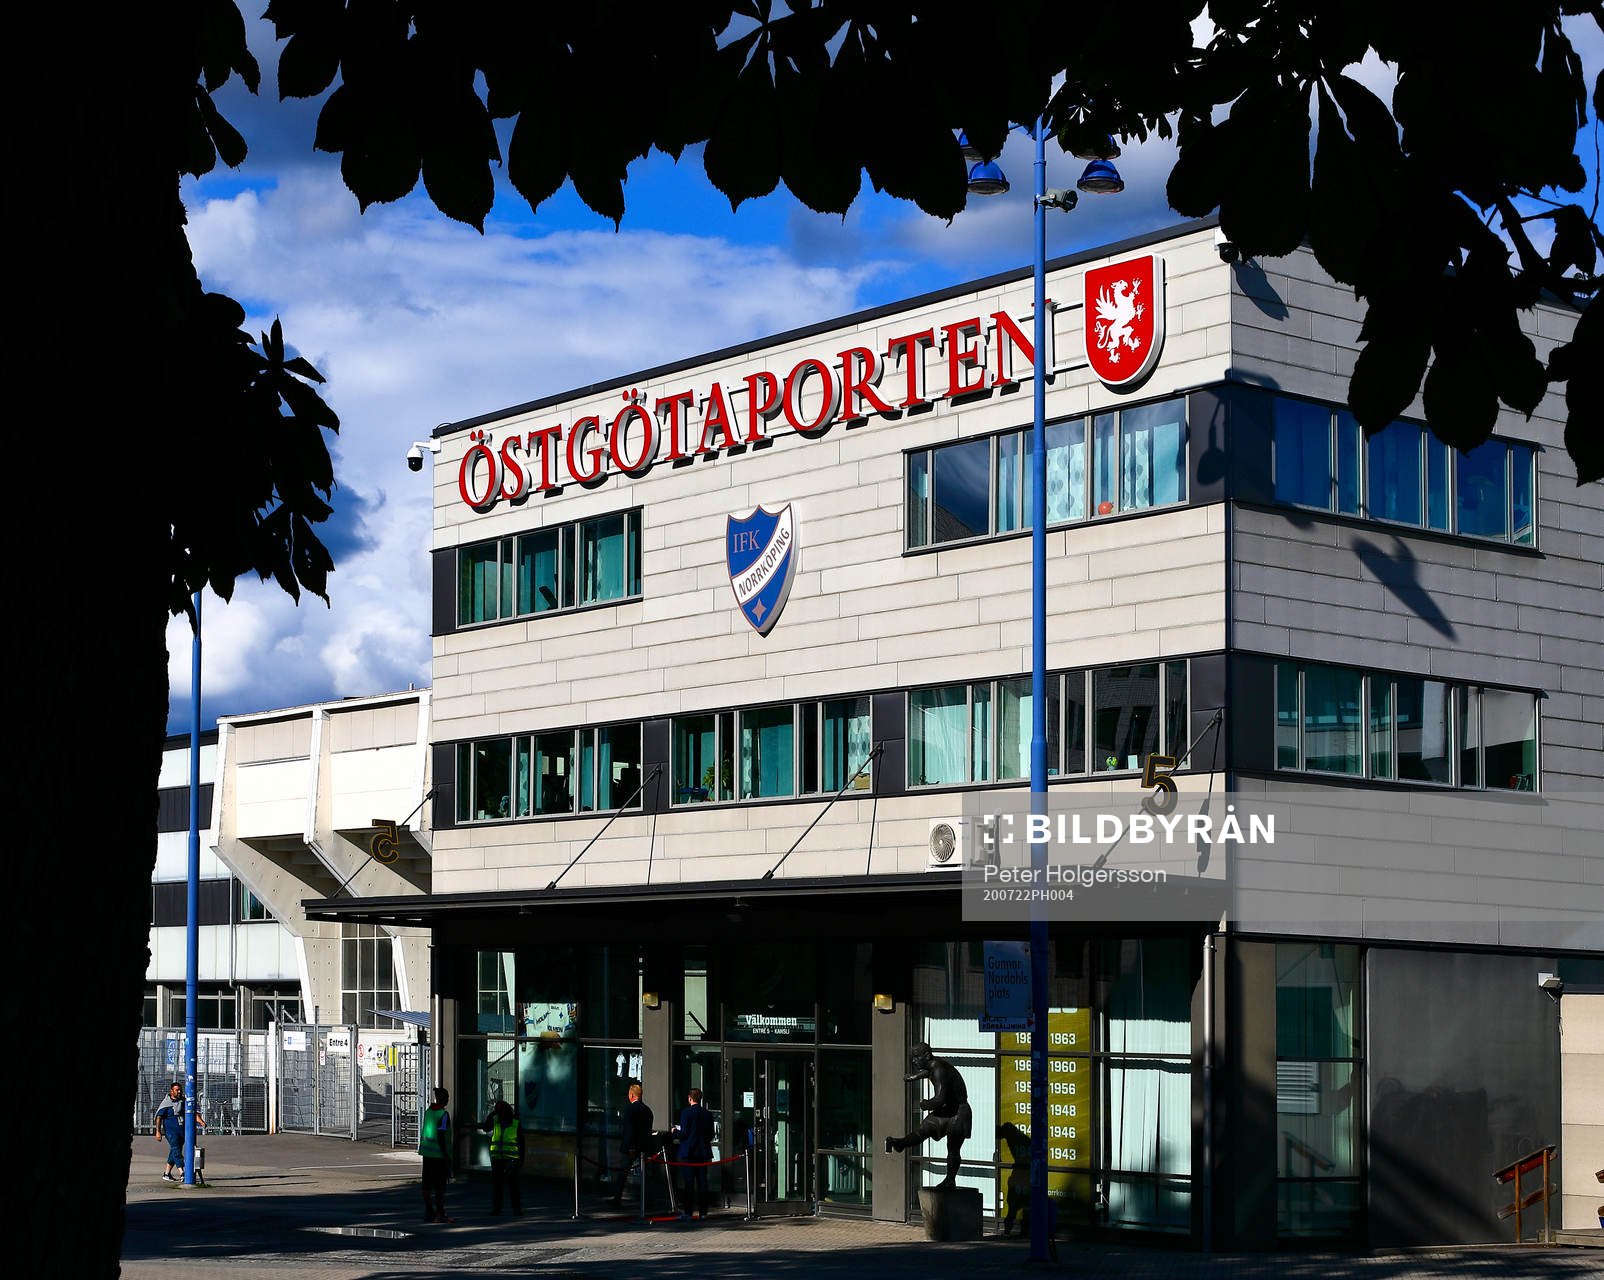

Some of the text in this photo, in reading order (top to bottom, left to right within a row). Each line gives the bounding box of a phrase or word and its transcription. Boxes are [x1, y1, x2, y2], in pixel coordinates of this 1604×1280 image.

[458, 298, 1054, 508] ÖSTGÖTAPORTEN
[732, 529, 761, 554] IFK
[738, 527, 790, 598] NORRKÖPING
[1140, 755, 1179, 817] 5
[988, 956, 1021, 969] Gunnar
[988, 970, 1029, 985] Nordahls
[988, 985, 1010, 1001] plats
[745, 1014, 798, 1026] Välkommen
[344, 1038, 349, 1047] 4
[1049, 1033, 1076, 1045] 1963
[1049, 1060, 1077, 1073] 1960
[1049, 1082, 1076, 1095] 1956
[1049, 1104, 1076, 1117] 1948
[1049, 1126, 1076, 1139] 1946
[1049, 1147, 1077, 1161] 1943
